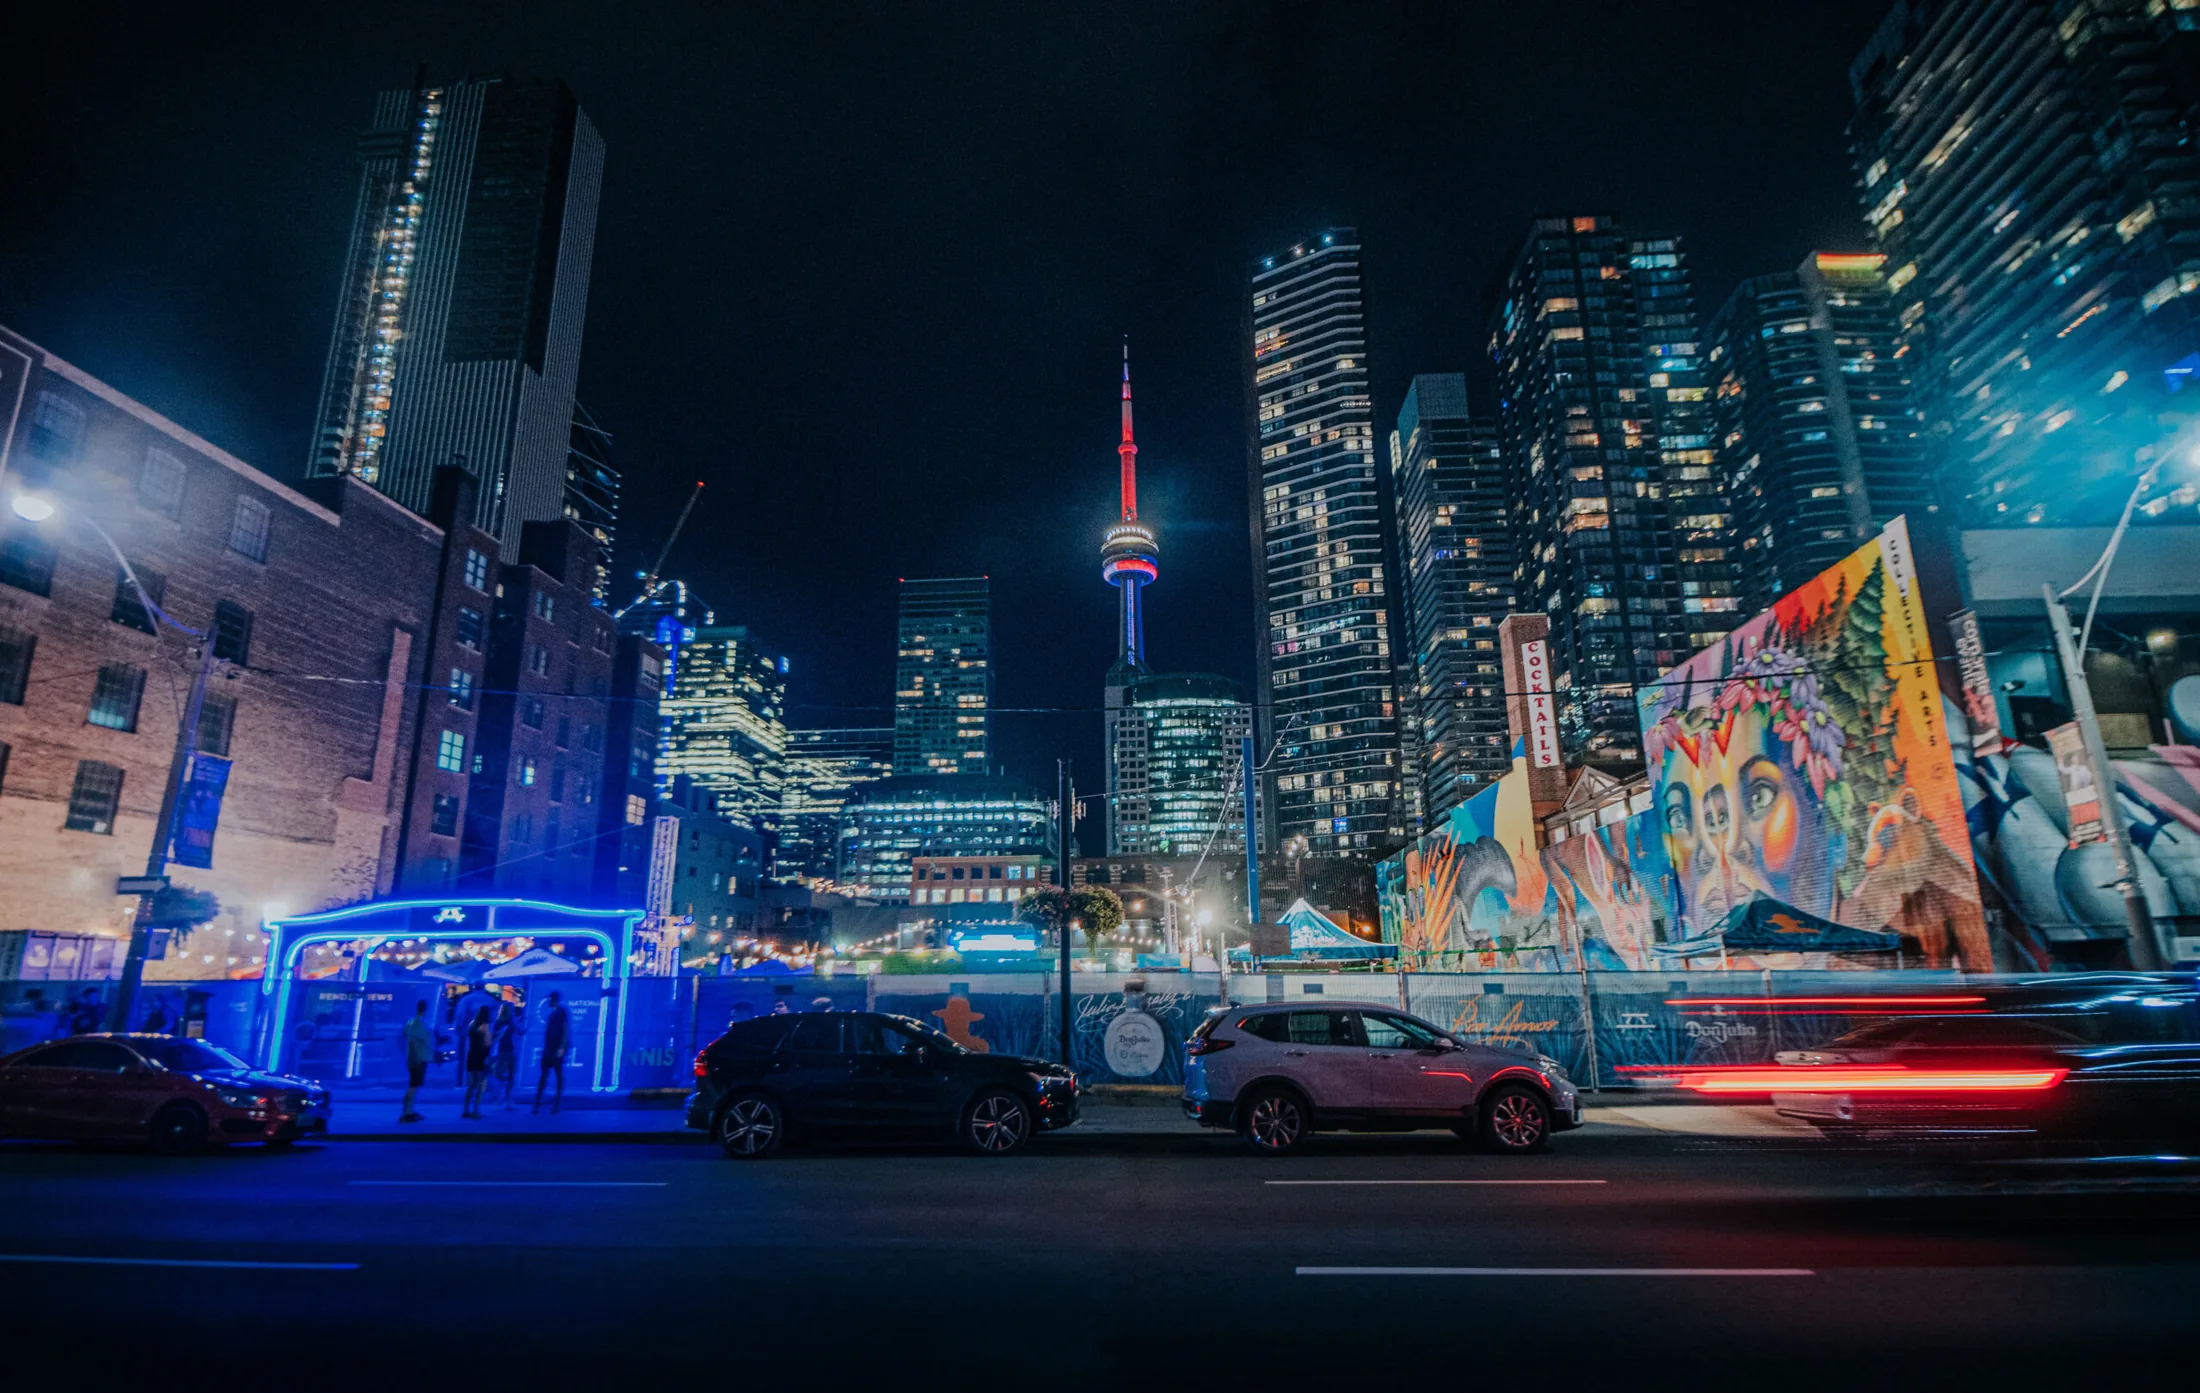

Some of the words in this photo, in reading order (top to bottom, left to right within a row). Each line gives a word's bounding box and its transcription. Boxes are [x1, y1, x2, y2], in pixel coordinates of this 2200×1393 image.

[1527, 642, 1552, 765] COCKTAILS
[1920, 690, 1937, 747] ARTS
[1450, 994, 1486, 1034] Por
[1489, 1000, 1559, 1042] Amor
